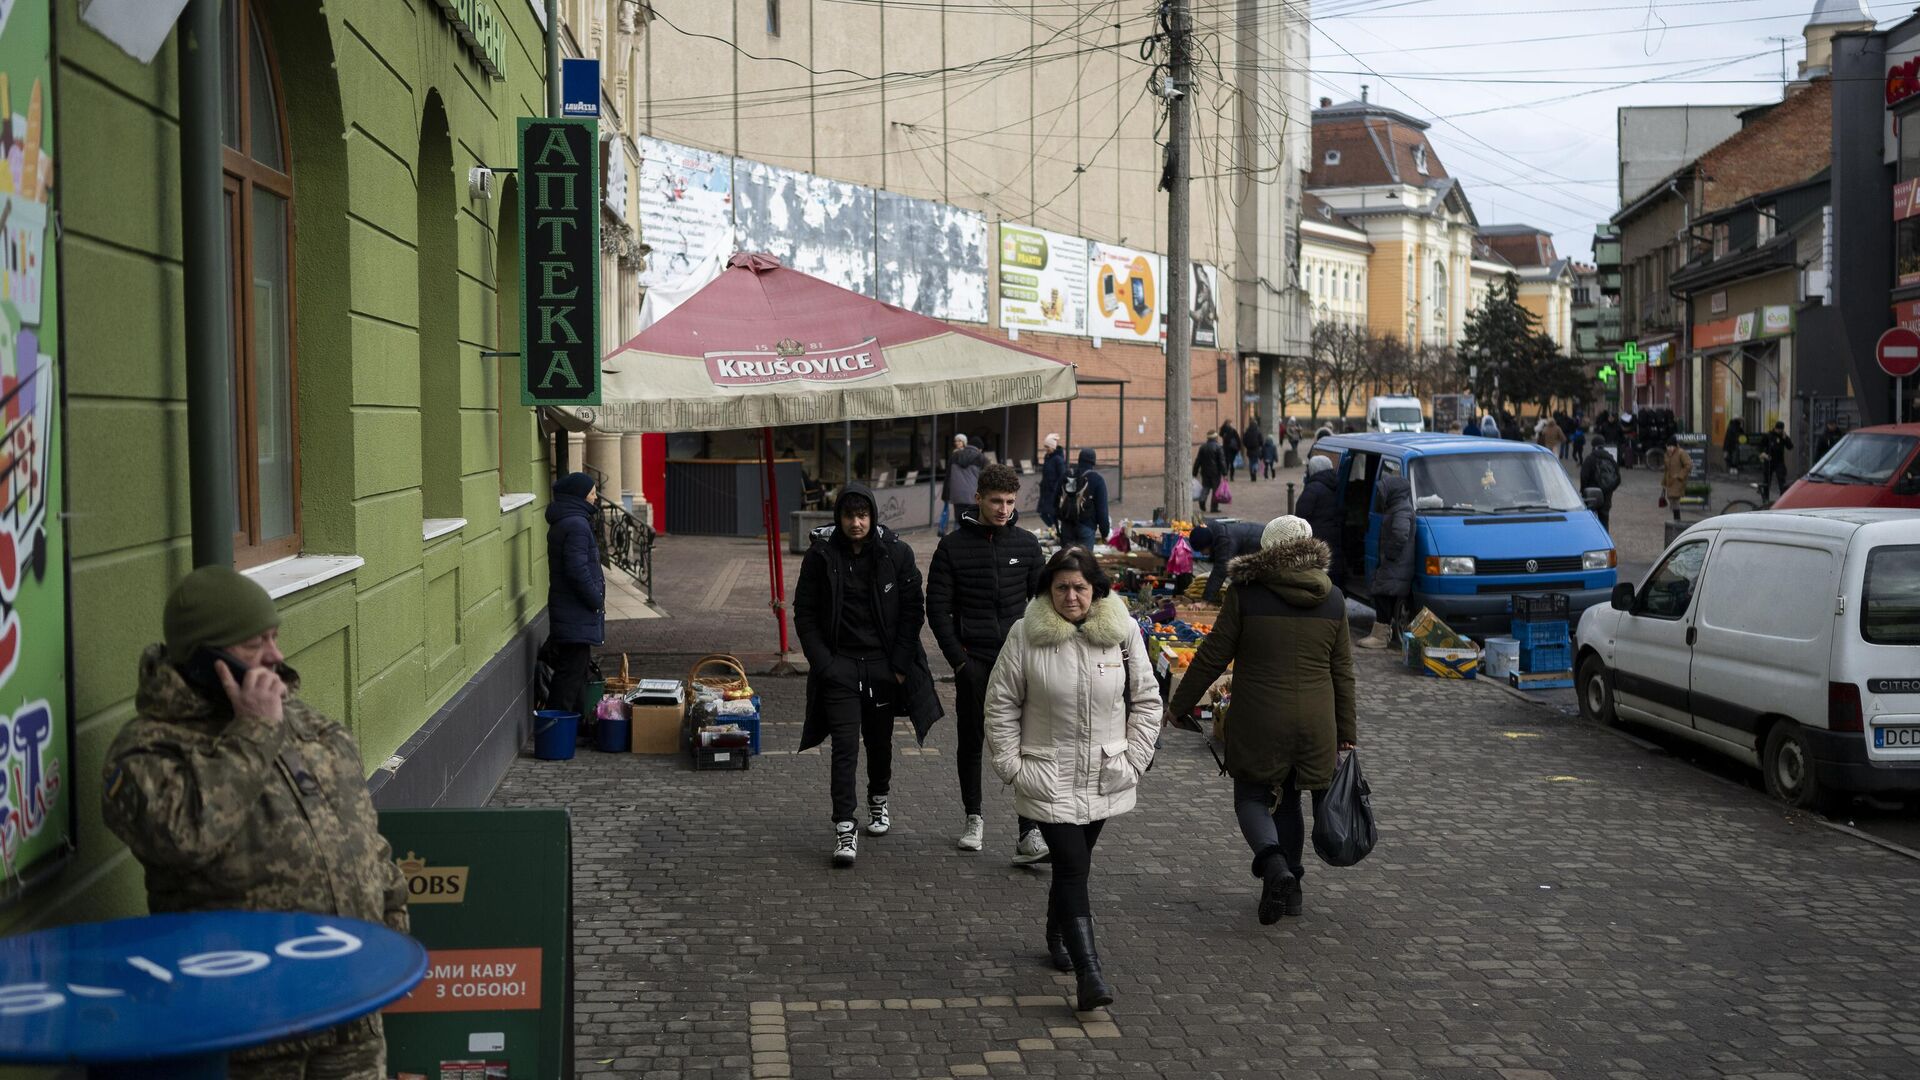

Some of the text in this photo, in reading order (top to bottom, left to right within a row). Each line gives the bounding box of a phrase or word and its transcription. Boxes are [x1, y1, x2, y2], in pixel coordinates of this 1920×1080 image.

[565, 101, 597, 111] LAVAZZA
[534, 127, 582, 389] АПТЕКА
[717, 352, 877, 378] KRUŠOVICE
[599, 400, 668, 430] ЧРЕЗМЕРНОЕ
[673, 398, 753, 428] УПОТРЕБЛЕНИЕ
[900, 385, 938, 413] ВРЕДИТ
[944, 381, 986, 409] ВАШЕМУ
[992, 374, 1043, 404] ЗДОРОВЬЮ
[1879, 680, 1920, 690] CITRO
[1886, 729, 1920, 745] DCD
[1, 758, 60, 878] plus
[408, 875, 460, 895] OBS
[471, 963, 517, 978] КАВУ
[436, 982, 526, 998] З СОБОЮ!
